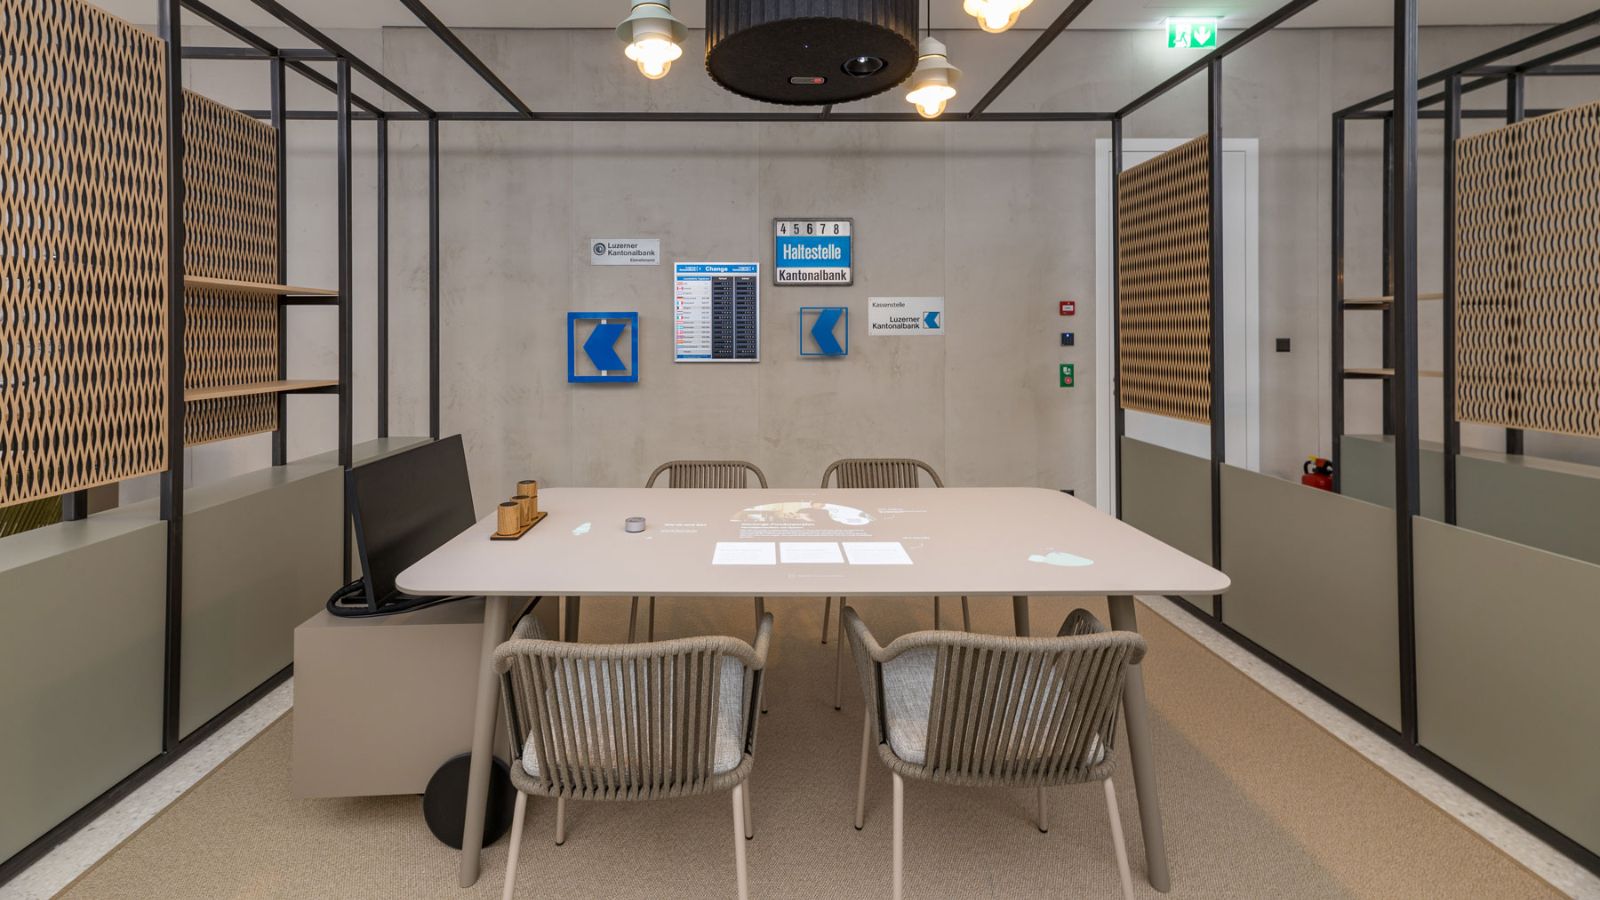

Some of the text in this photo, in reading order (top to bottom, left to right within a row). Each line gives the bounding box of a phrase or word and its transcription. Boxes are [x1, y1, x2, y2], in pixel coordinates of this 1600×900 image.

[780, 222, 840, 235] 4 5 6 7 8
[783, 243, 842, 260] Haltestelle
[705, 265, 729, 273] Change
[778, 269, 847, 281] Kantonalbank
